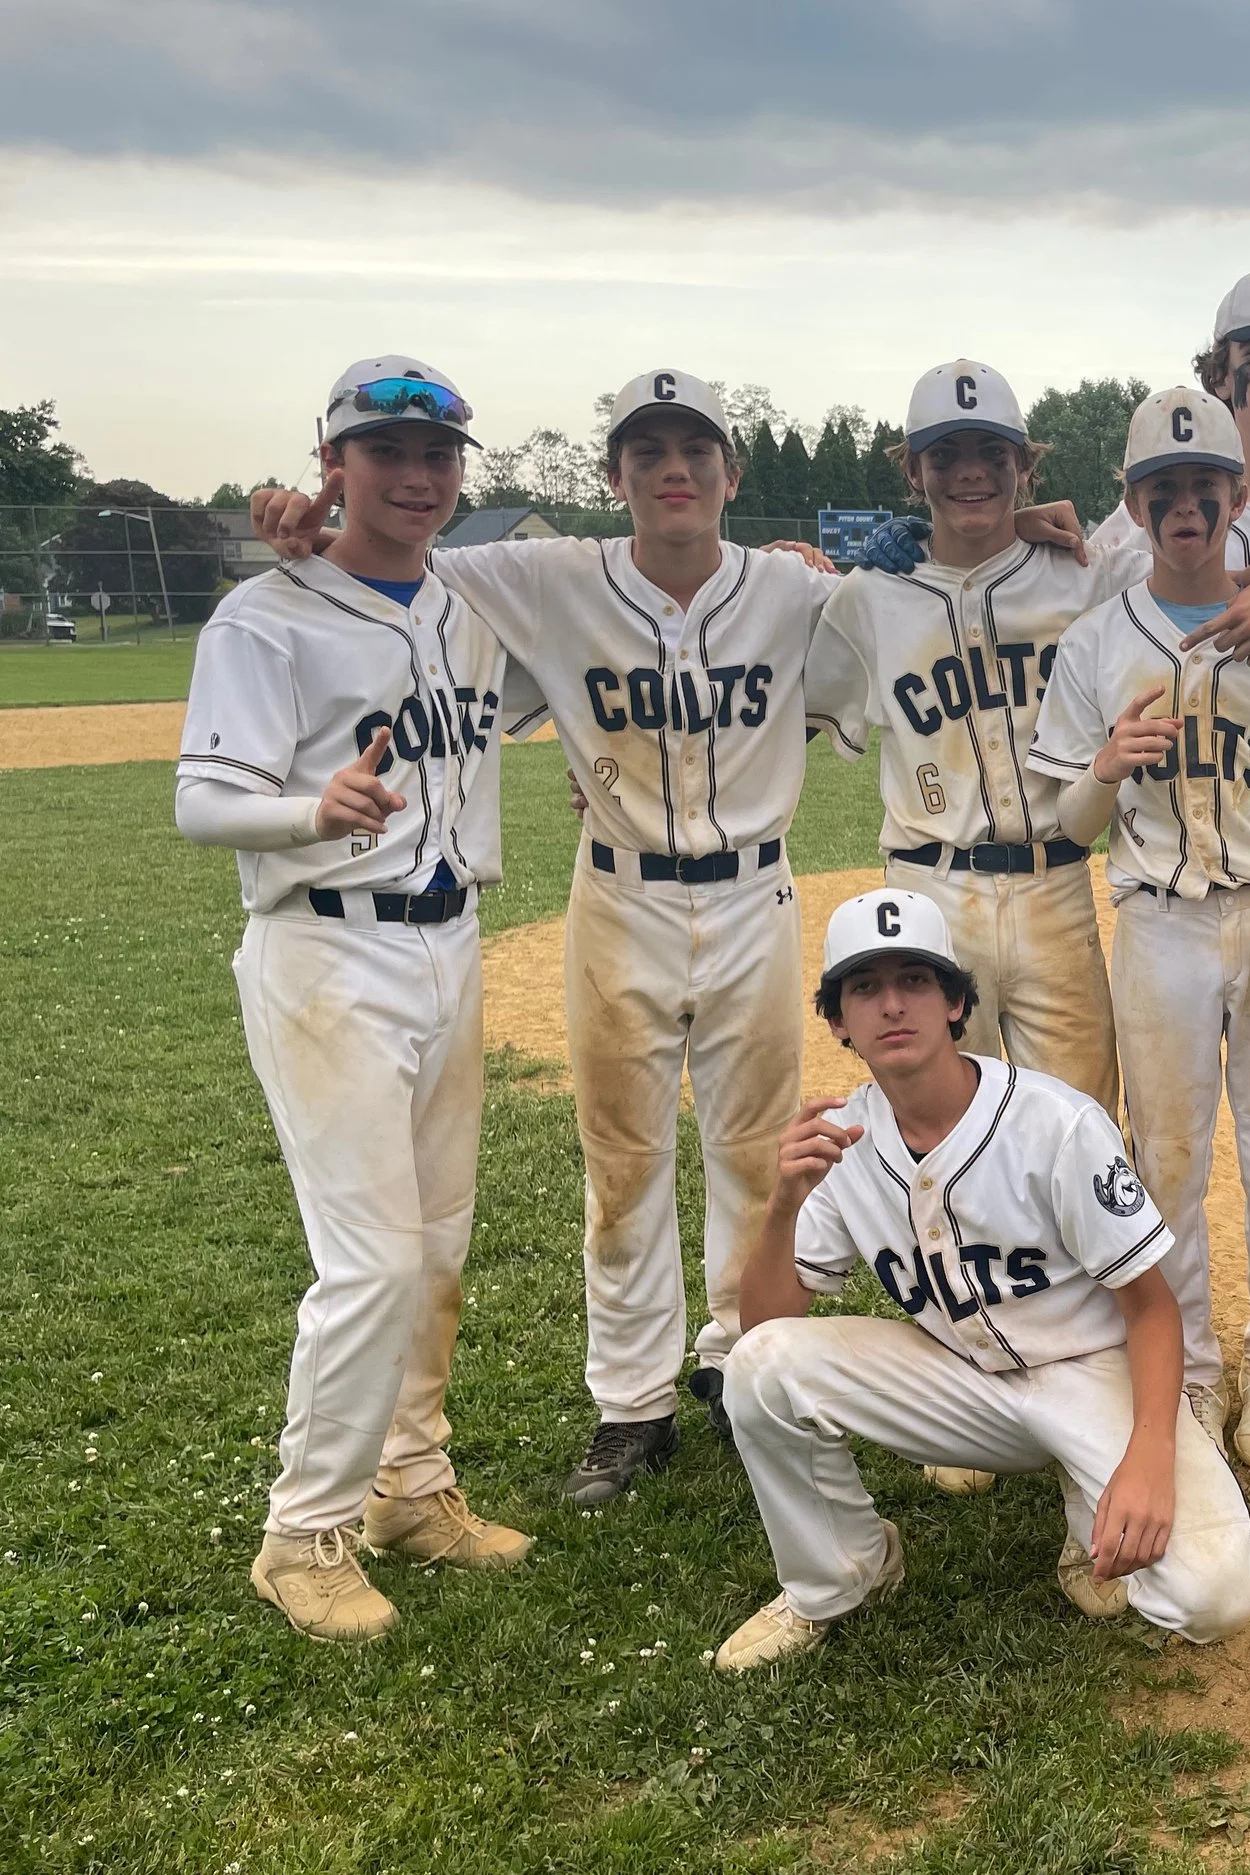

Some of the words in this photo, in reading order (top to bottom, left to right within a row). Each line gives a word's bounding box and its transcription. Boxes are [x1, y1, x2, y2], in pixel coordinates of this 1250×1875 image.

[654, 374, 676, 400] C
[956, 376, 977, 409] C
[1172, 406, 1192, 442] C
[584, 664, 774, 735] COLTS
[354, 686, 499, 776] COLTS
[594, 757, 621, 808] 2
[916, 762, 947, 815] 6
[877, 902, 900, 936] C
